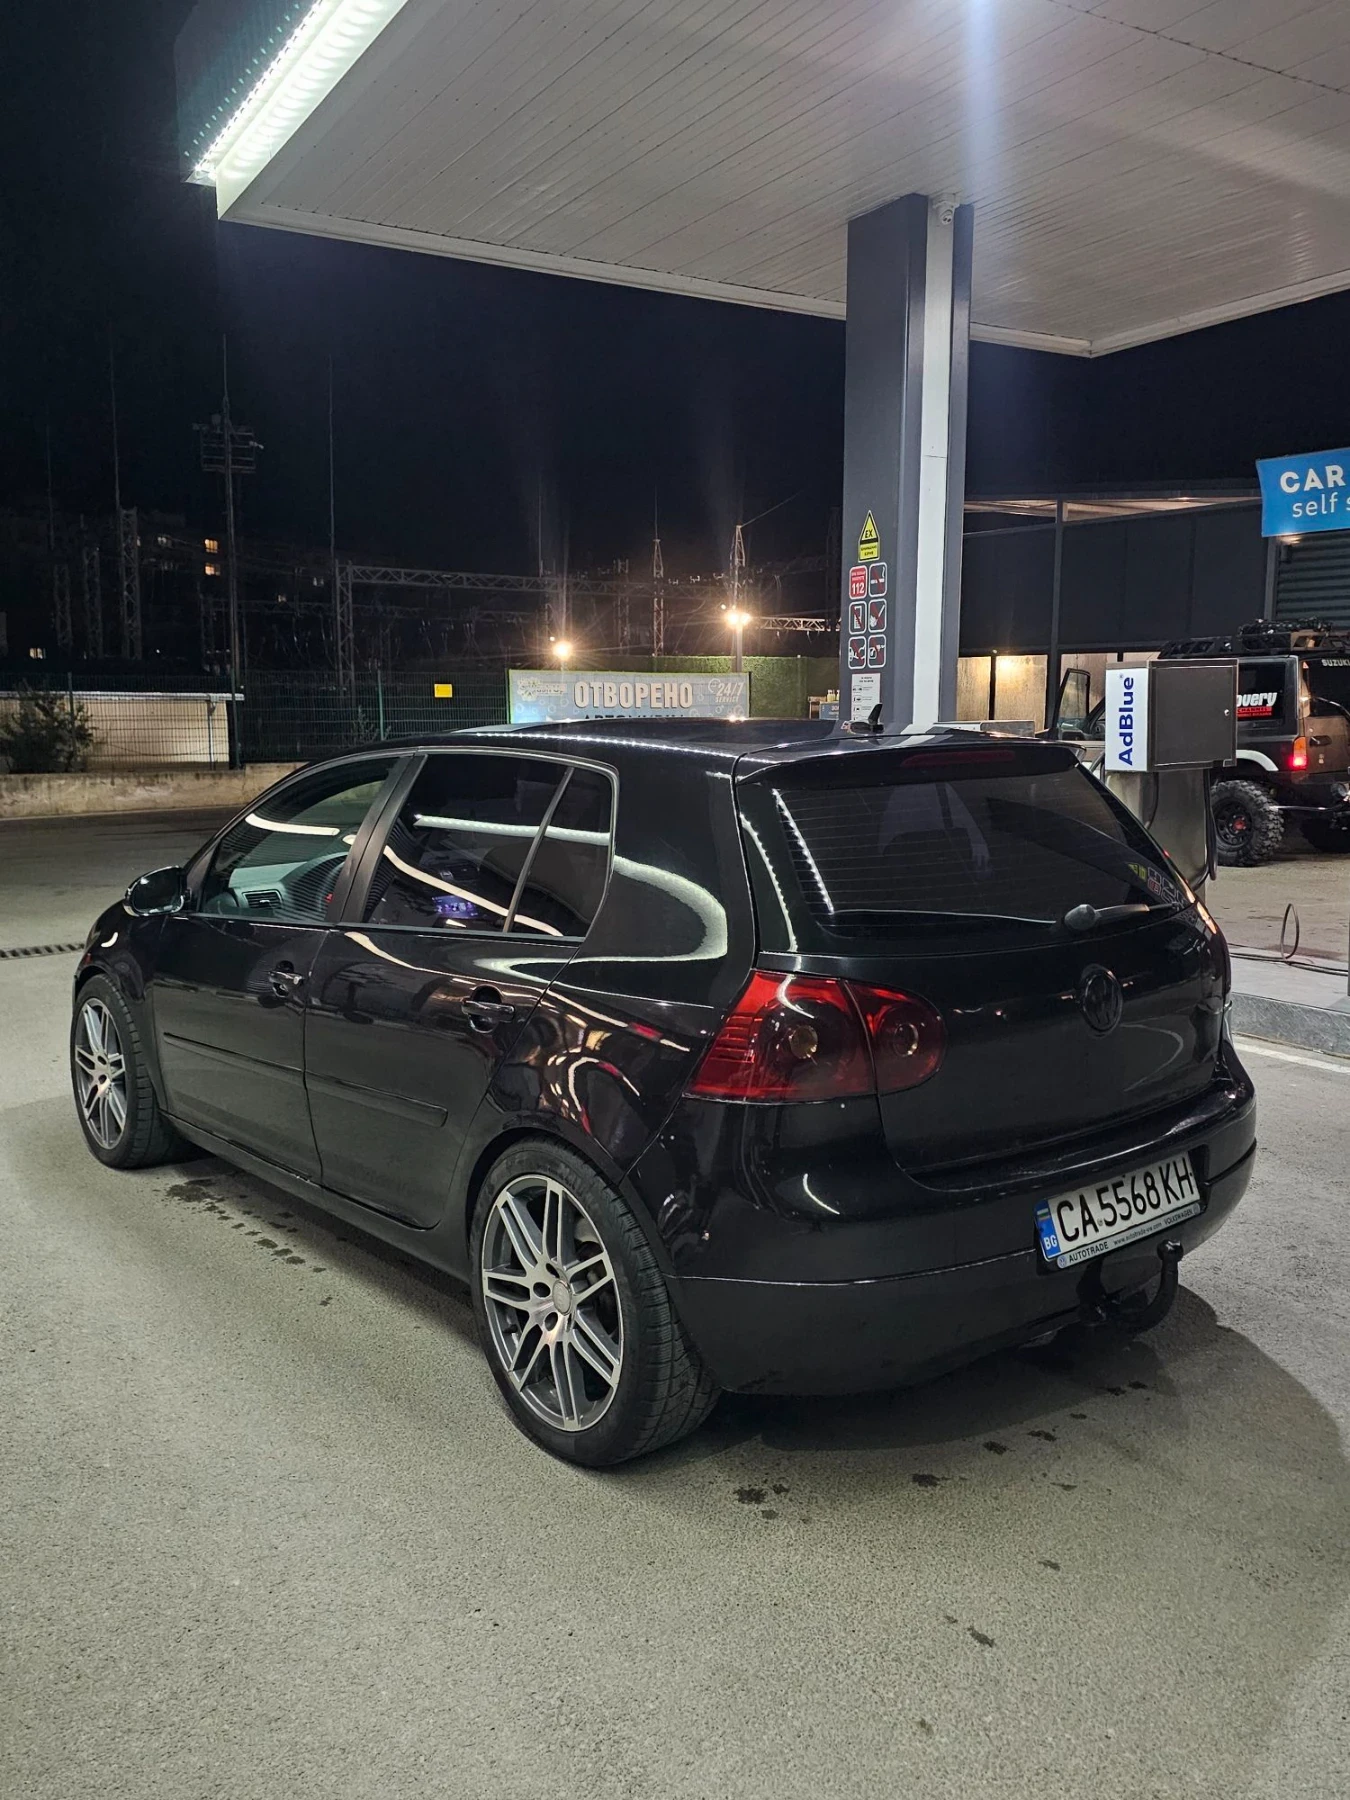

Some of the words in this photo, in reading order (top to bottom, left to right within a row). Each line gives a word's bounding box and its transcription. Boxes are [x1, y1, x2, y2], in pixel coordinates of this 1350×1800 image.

[1280, 464, 1347, 493] CAR
[1292, 491, 1339, 518] self
[865, 529, 873, 539] EX
[852, 582, 865, 595] 112
[574, 681, 693, 709] ОТВОРЕНО
[716, 682, 745, 697] 24/7
[1118, 677, 1134, 766] AdBlue
[1043, 1234, 1057, 1250] BG
[1068, 1241, 1109, 1263] AUTOTRADE
[1164, 1209, 1193, 1225] VOLKSWAGEN
